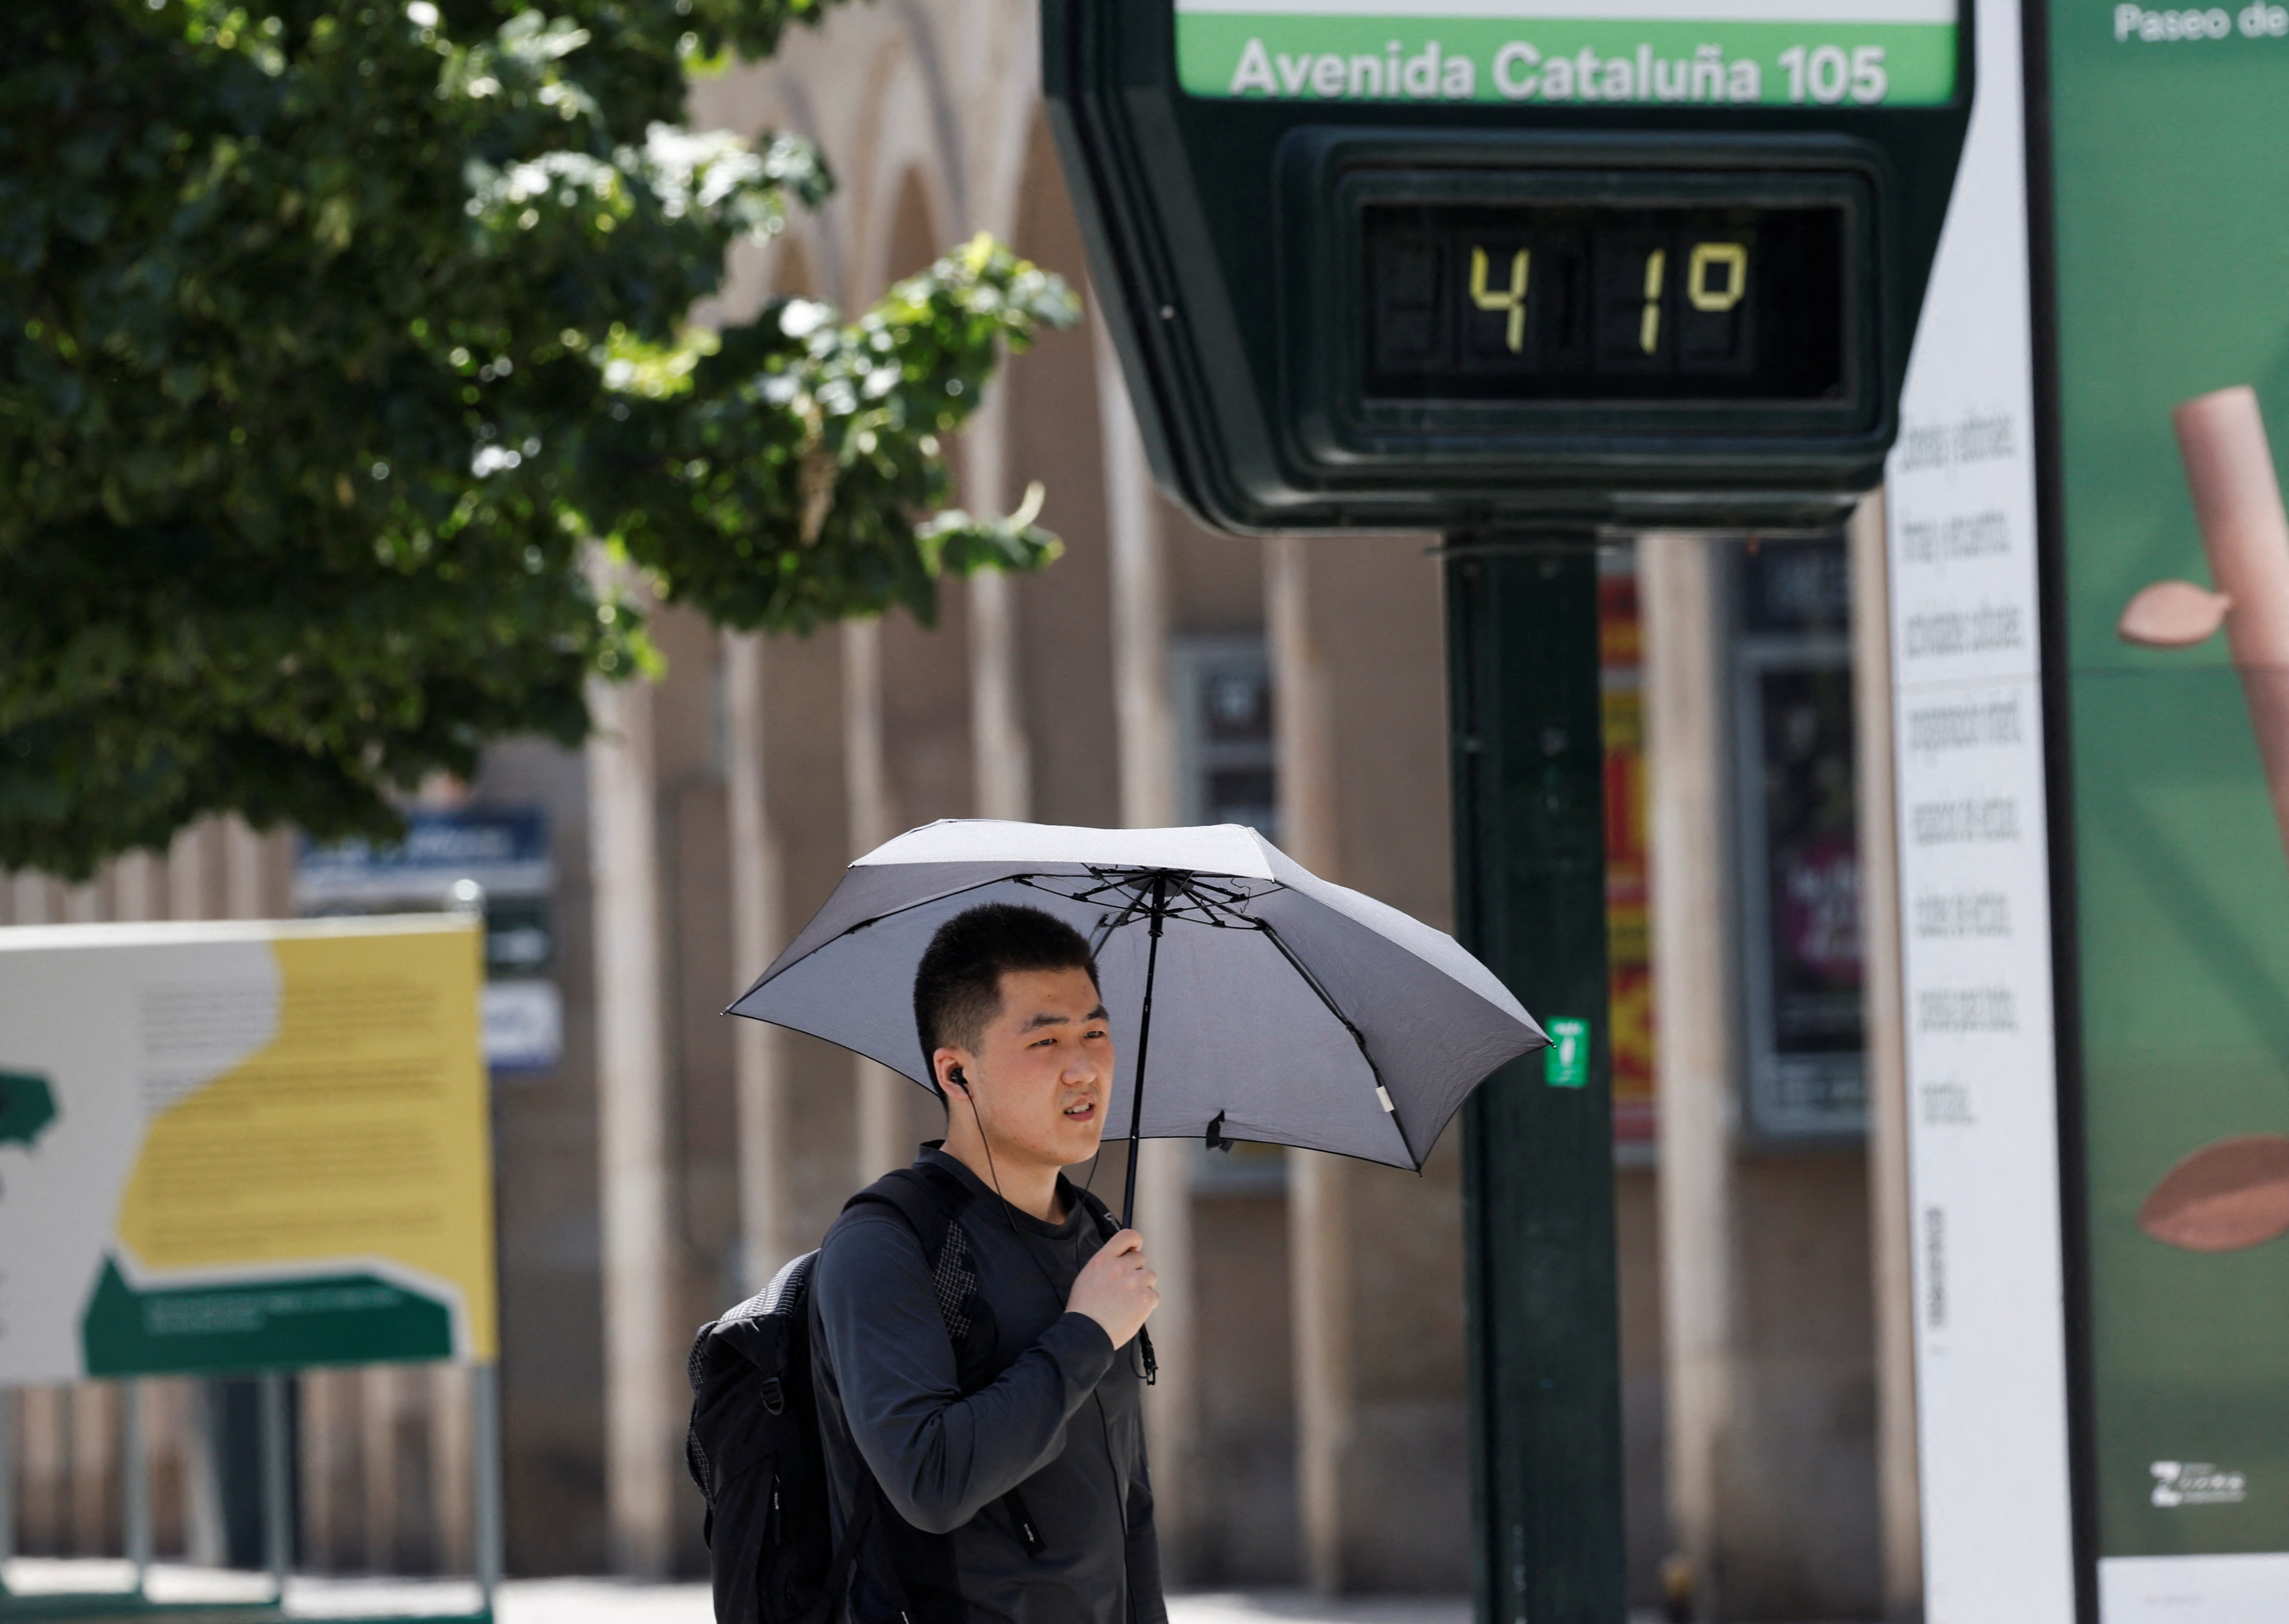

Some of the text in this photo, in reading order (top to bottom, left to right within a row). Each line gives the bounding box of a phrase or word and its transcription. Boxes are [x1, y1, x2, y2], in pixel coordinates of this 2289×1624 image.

[2114, 3, 2231, 42] Paseo
[1229, 37, 1889, 104] Avenida Cataluña 105
